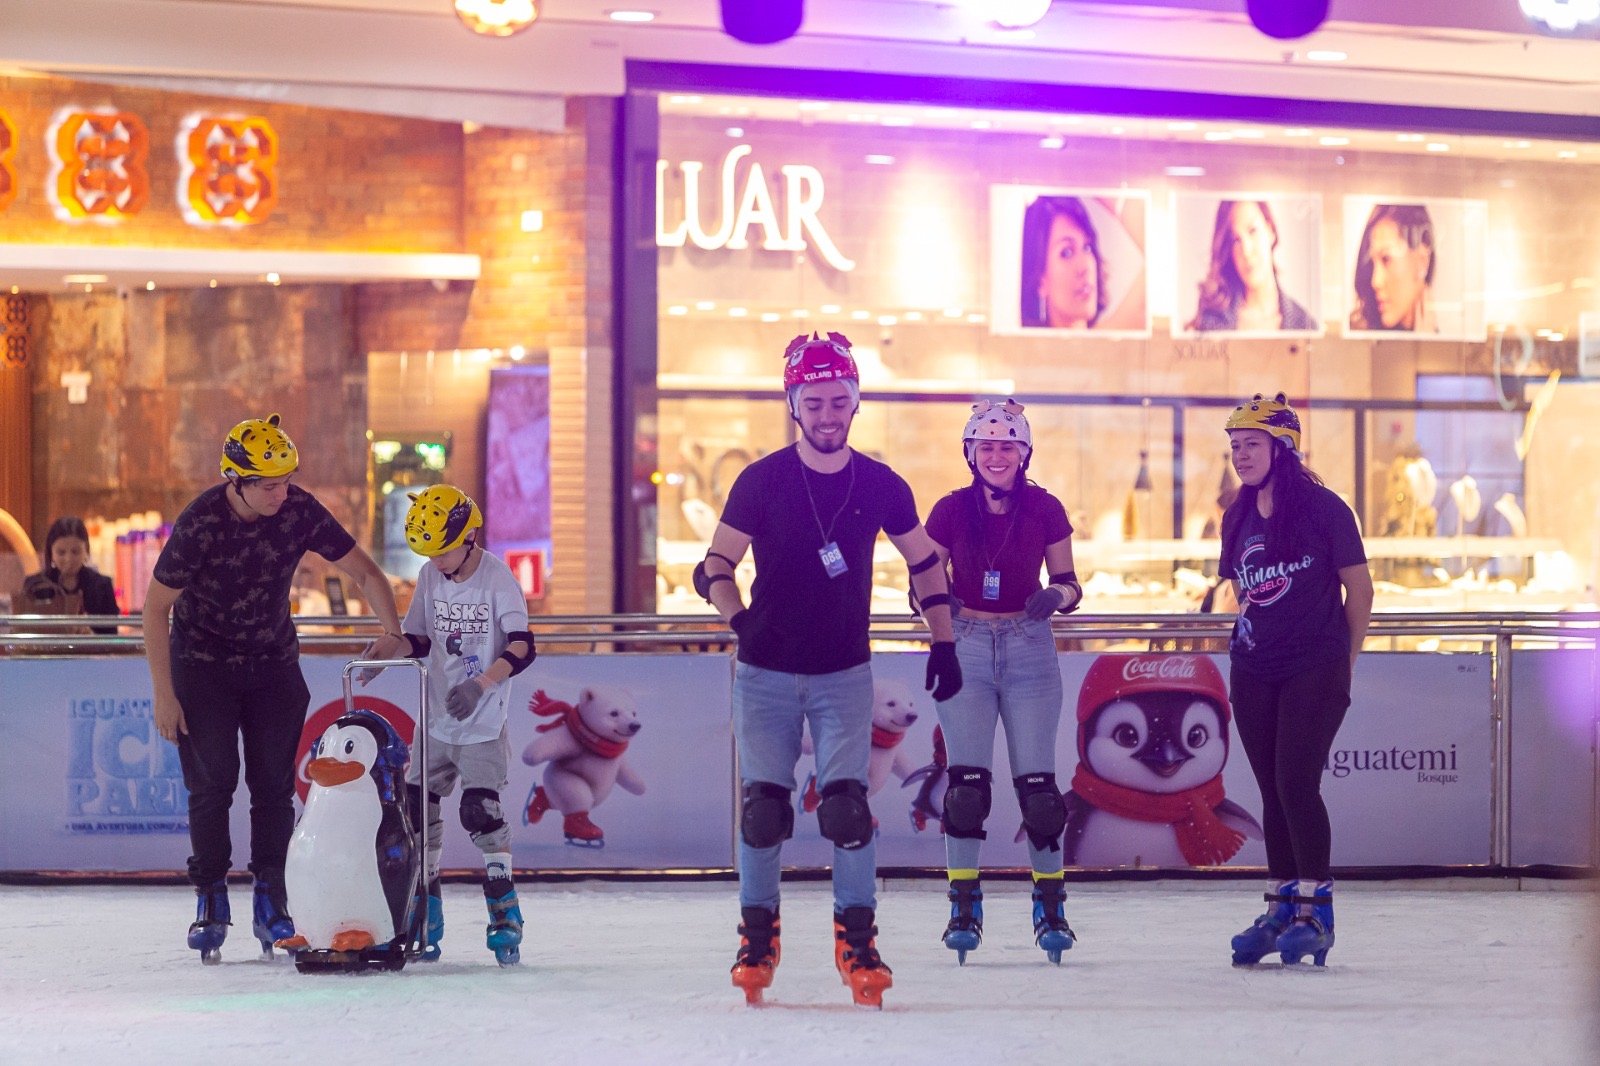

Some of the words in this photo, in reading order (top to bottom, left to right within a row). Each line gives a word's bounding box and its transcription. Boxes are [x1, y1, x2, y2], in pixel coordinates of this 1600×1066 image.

[433, 600, 489, 622] ASKS
[434, 618, 489, 634] MPLETE
[68, 699, 154, 720] IGUAT
[1417, 772, 1458, 785] Bosque
